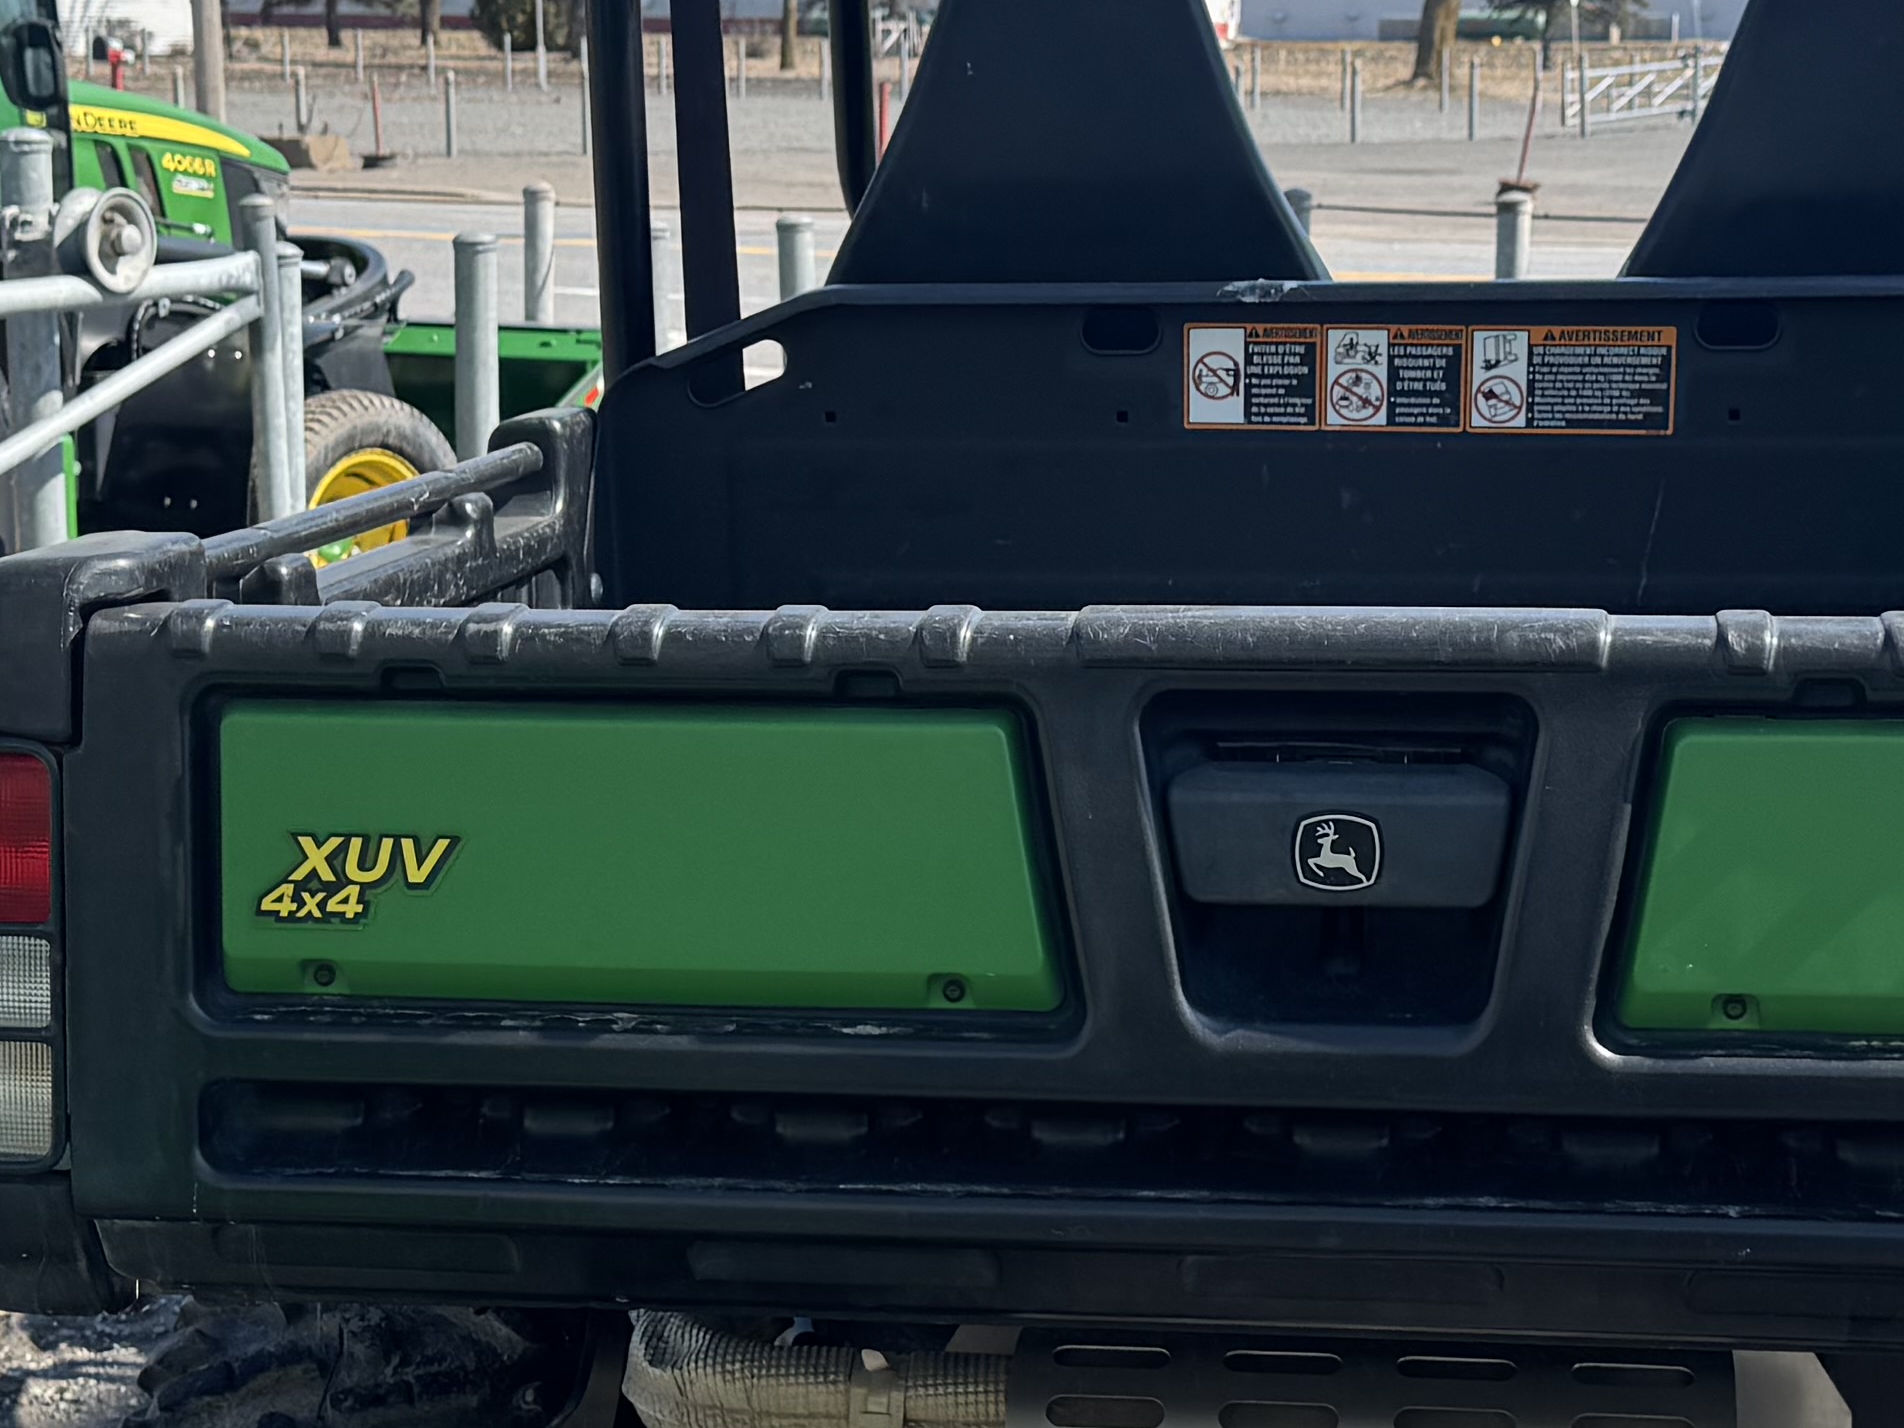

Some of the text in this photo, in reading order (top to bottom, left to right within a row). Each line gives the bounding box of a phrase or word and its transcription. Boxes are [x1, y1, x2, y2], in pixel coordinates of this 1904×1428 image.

[1559, 330, 1663, 342] AVERTISSEMENT
[287, 835, 451, 883] XUV
[260, 883, 364, 918] 4x4
